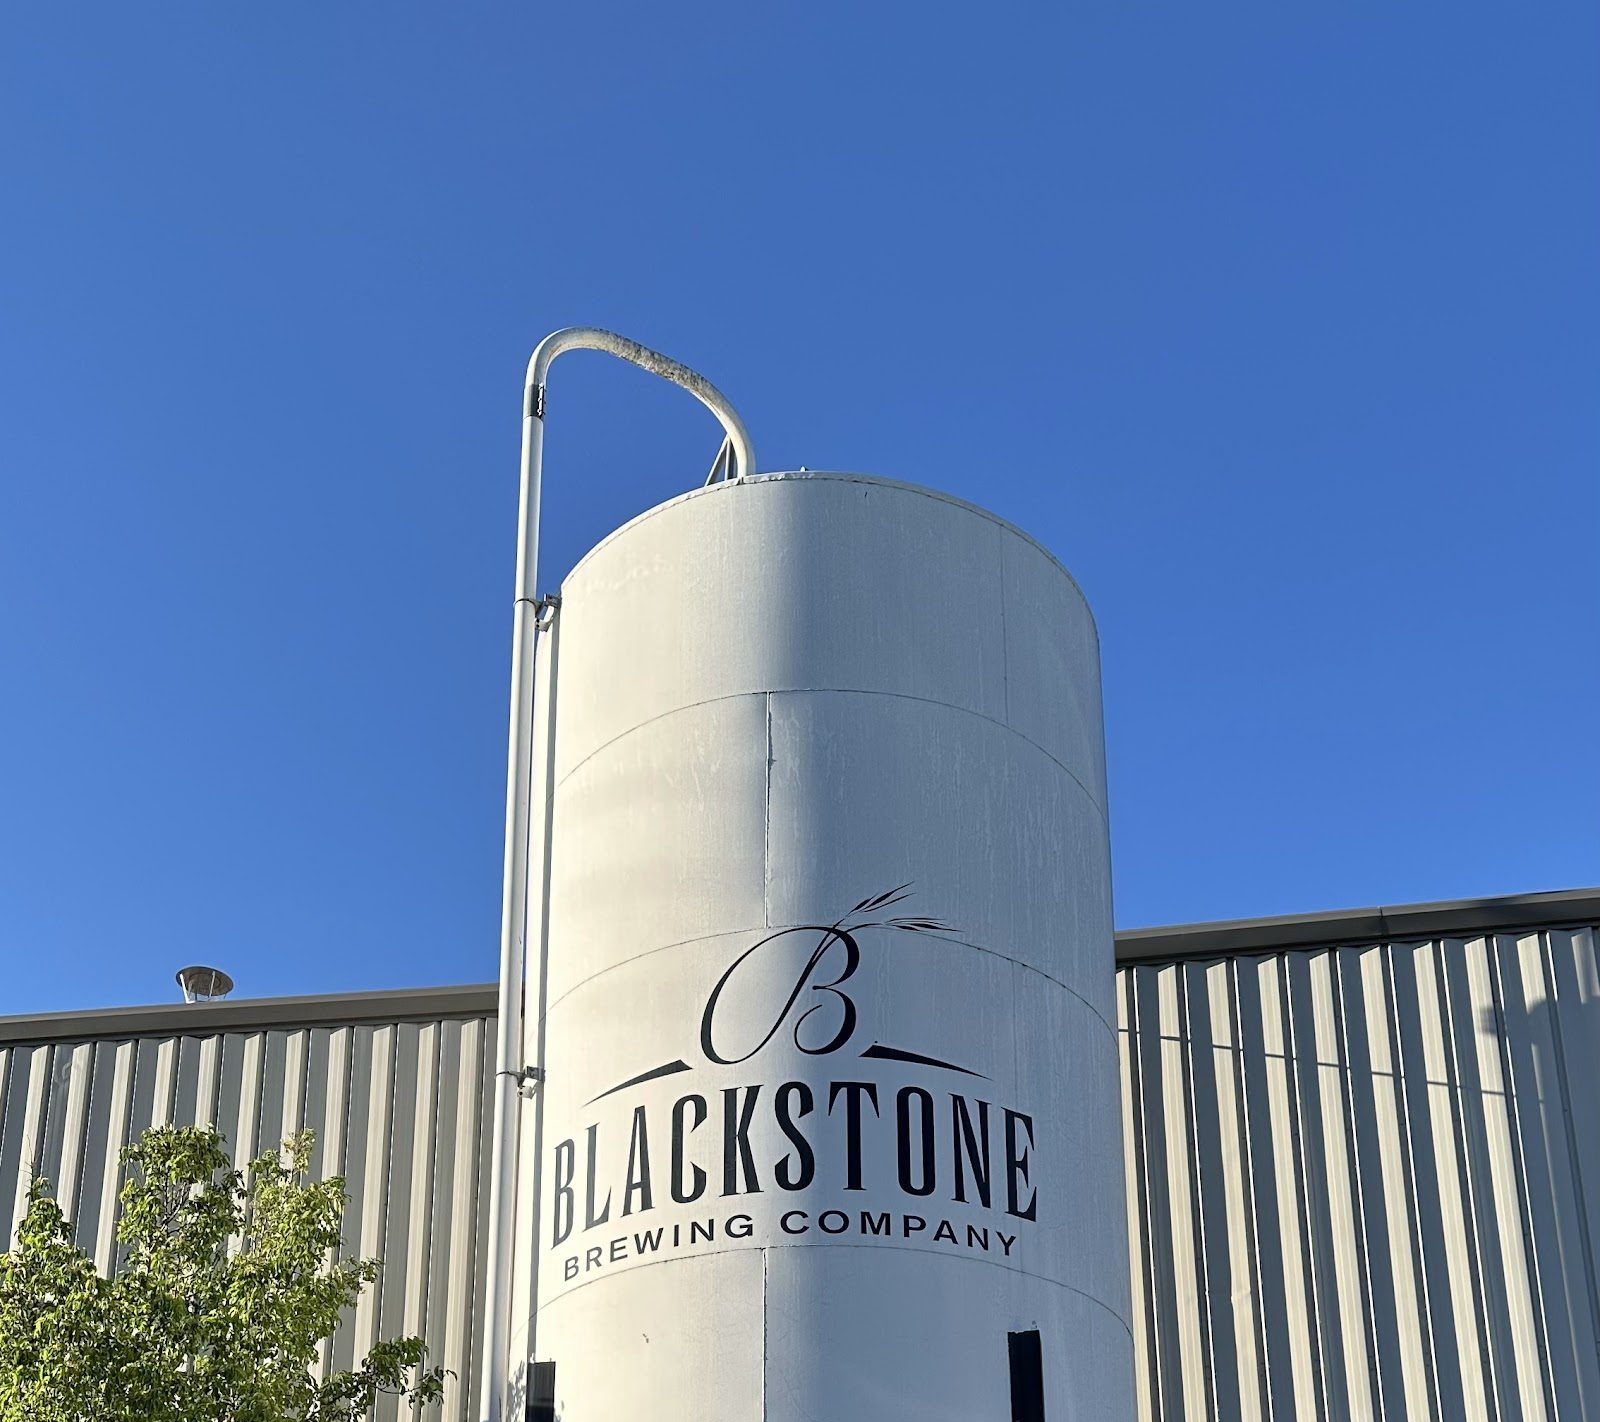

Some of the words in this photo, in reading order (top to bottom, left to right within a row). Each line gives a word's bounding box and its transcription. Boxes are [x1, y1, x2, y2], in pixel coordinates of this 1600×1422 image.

[550, 1081, 1038, 1251] BLACKSTONE
[564, 1214, 754, 1282] BREWING
[780, 1210, 1017, 1256] COMPANY
